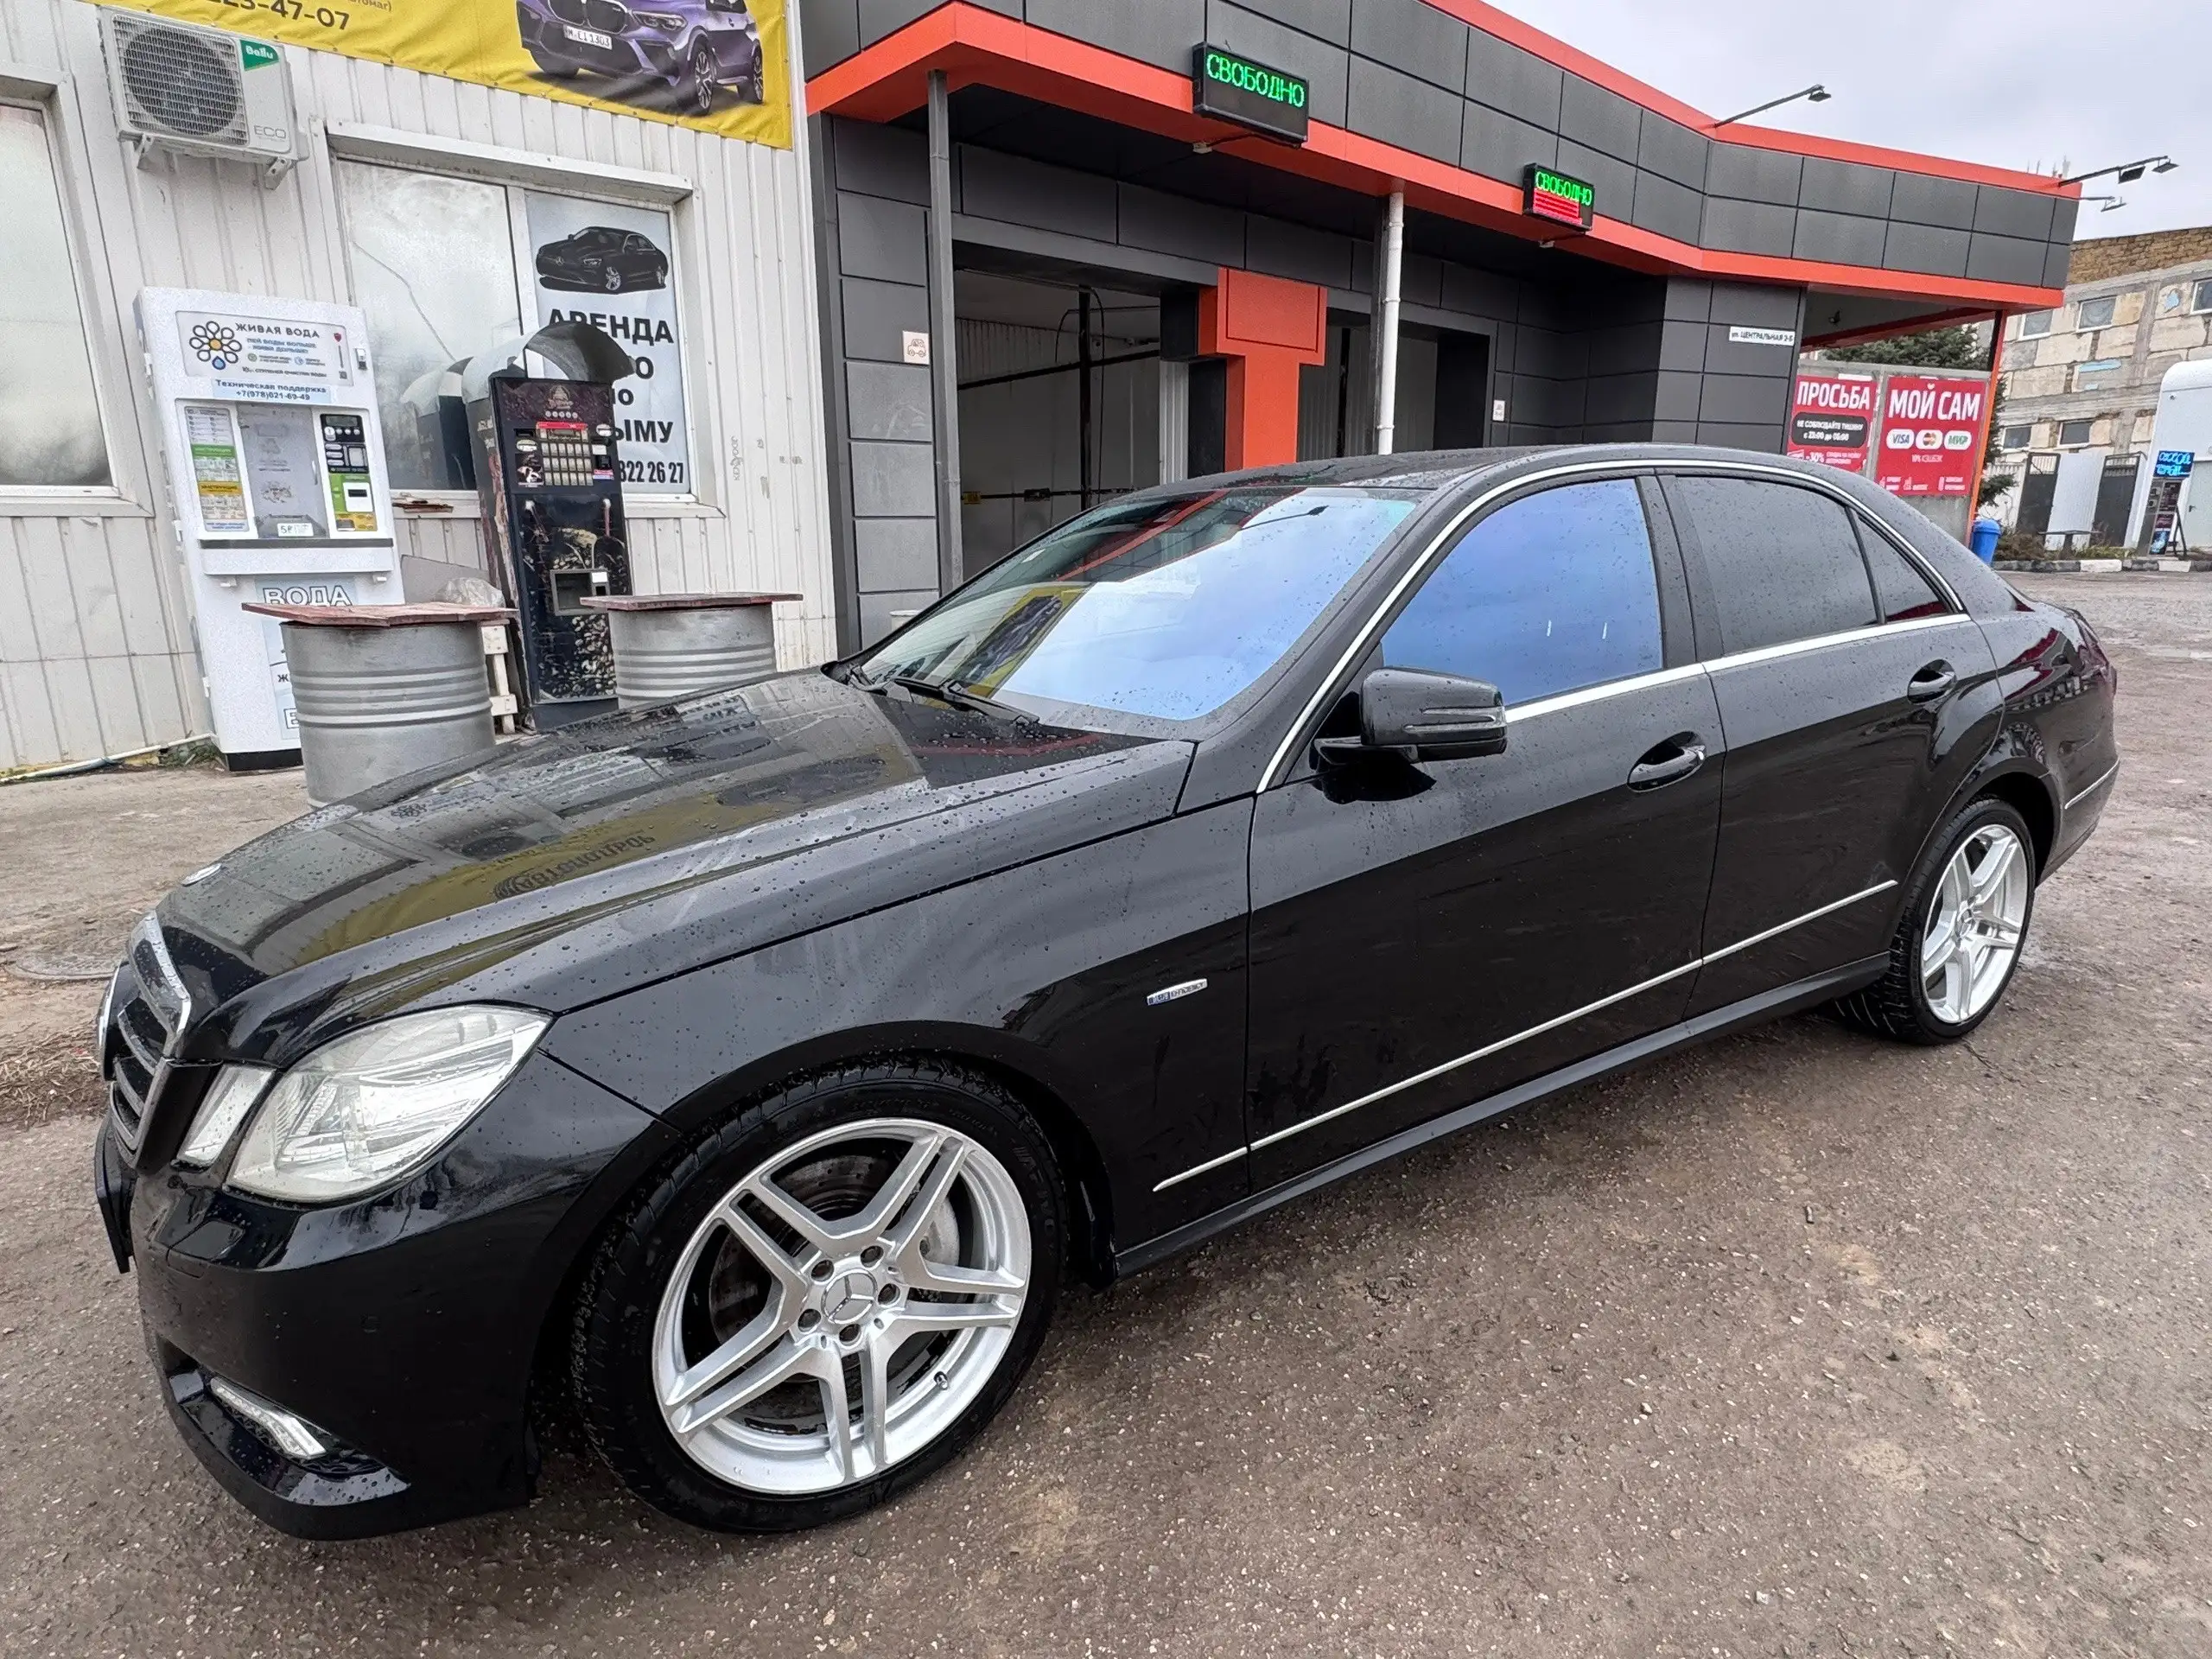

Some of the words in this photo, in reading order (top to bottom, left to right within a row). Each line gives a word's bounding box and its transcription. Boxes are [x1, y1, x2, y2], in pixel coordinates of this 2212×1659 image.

[245, 45, 274, 60] Ballu
[1206, 54, 1305, 108] СВОБОДНО
[253, 124, 287, 139] ECO
[1535, 171, 1592, 207] СВОБОДНО
[235, 322, 282, 335] ЖИВАЯ
[285, 327, 320, 338] ВОДА
[216, 379, 275, 391] Техническая
[277, 385, 327, 393] поддержка
[1796, 380, 1871, 411] ПРОСЬБА
[1888, 383, 1936, 420] МОЙ
[1937, 391, 1981, 422] САМ
[1892, 434, 1910, 444] VISA
[1948, 435, 1968, 446] МИР
[647, 461, 666, 484] 26
[668, 461, 683, 484] 27
[263, 585, 353, 607] ВОДА
